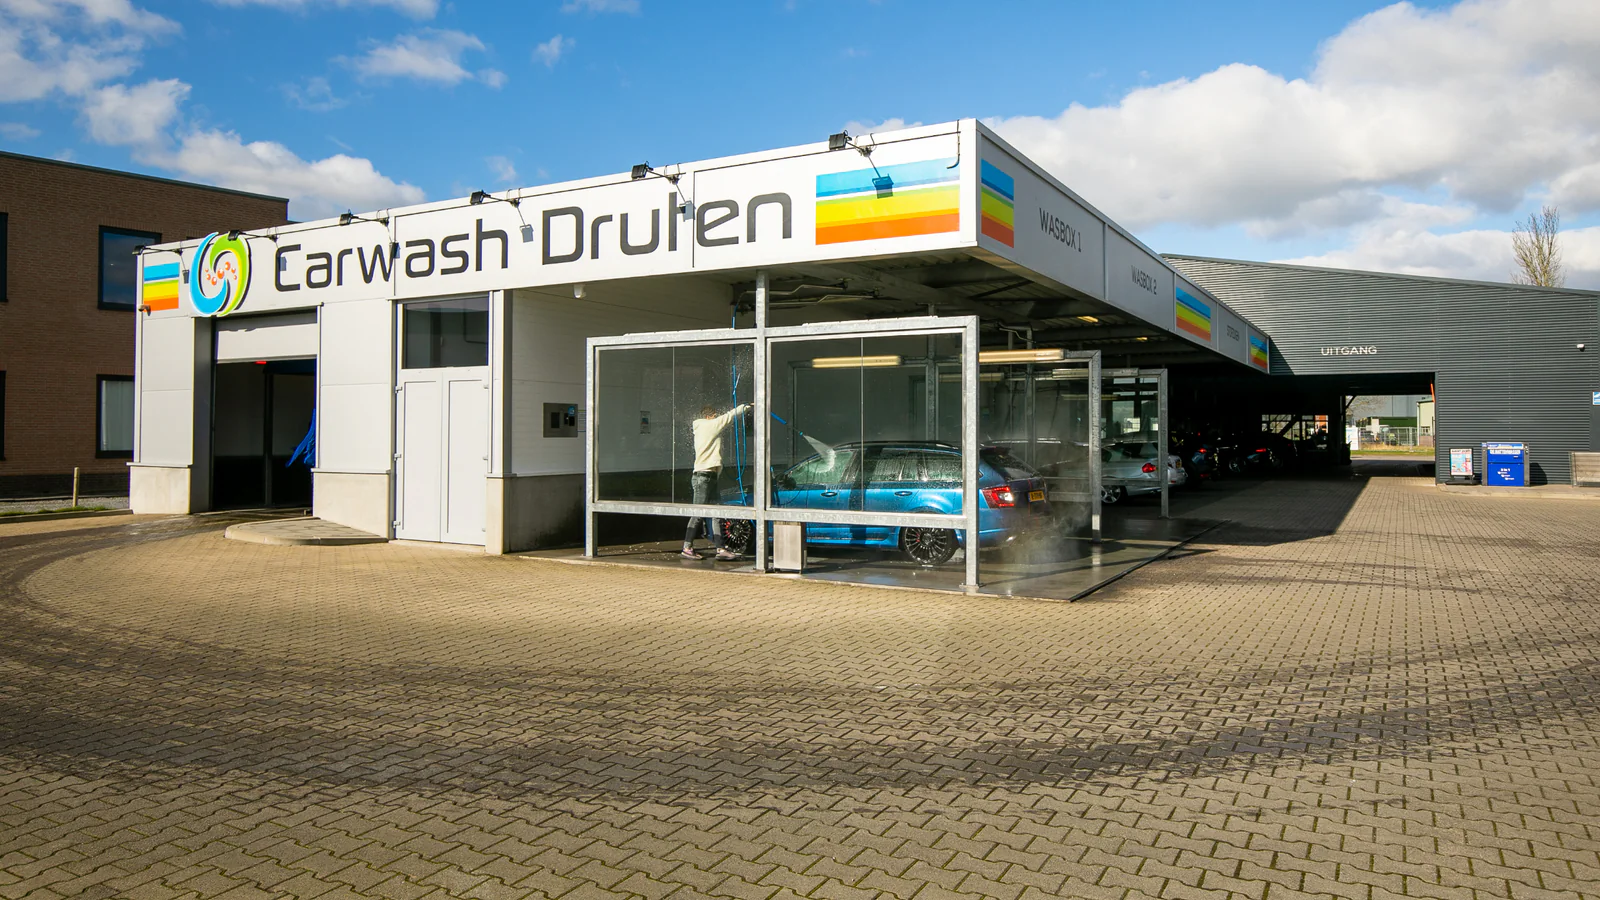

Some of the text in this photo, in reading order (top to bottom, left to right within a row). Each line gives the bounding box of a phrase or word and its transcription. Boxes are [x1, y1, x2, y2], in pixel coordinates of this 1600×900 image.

[275, 192, 792, 292] Carwash Druten
[1039, 207, 1082, 253] WASBOX 1
[1131, 265, 1157, 295] WASBOX 2
[1321, 345, 1378, 356] UITGANG
